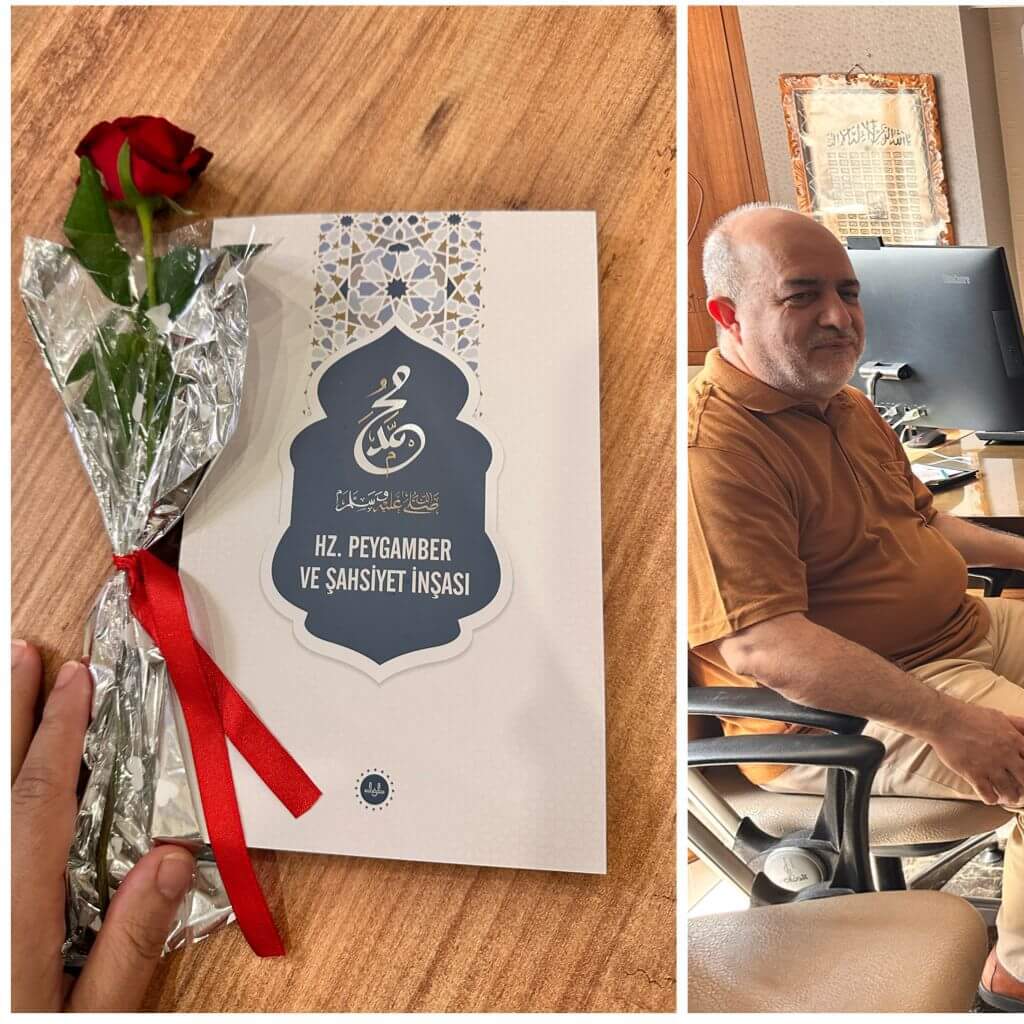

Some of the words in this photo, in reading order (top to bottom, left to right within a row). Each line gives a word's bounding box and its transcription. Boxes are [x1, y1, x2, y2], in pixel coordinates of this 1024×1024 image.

[314, 534, 342, 557] HZ.
[348, 535, 452, 561] PEYGAMBER
[300, 566, 321, 589] VE
[325, 564, 406, 595] ŞAHSİYET
[411, 566, 470, 599] İNŞASI
